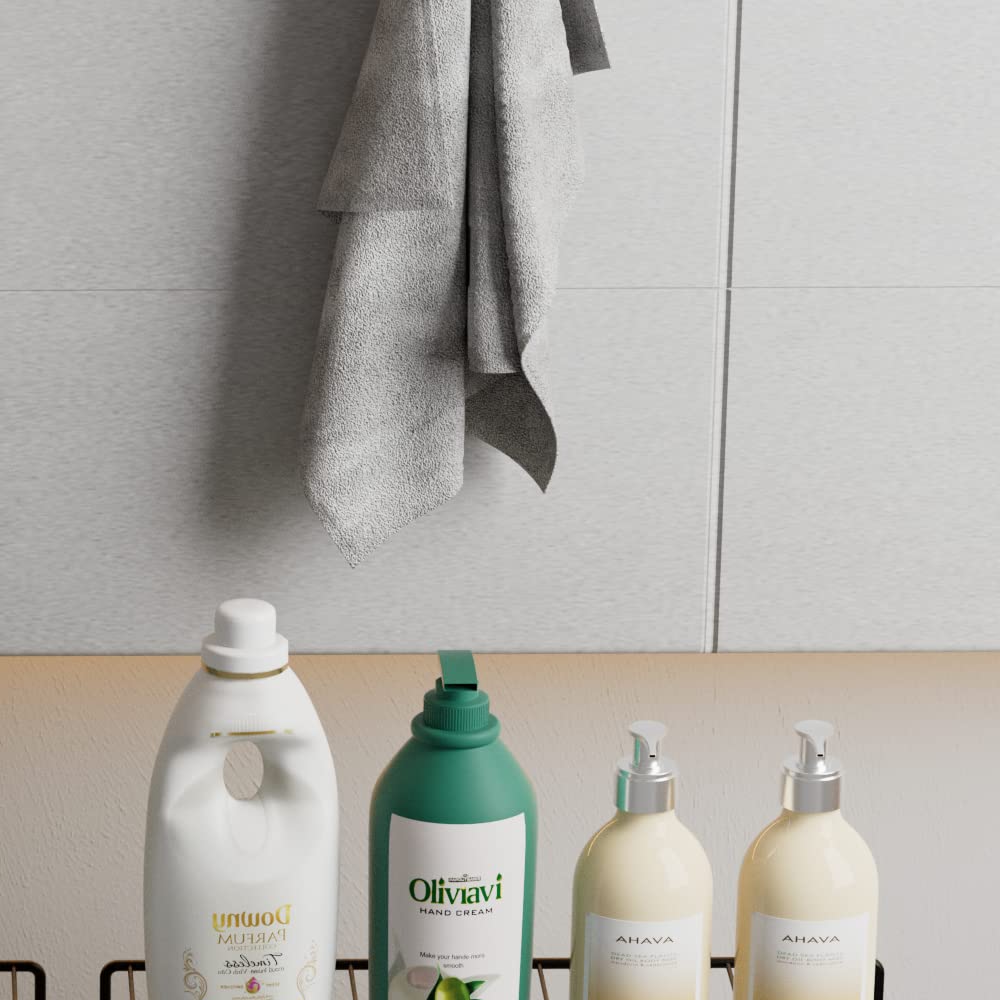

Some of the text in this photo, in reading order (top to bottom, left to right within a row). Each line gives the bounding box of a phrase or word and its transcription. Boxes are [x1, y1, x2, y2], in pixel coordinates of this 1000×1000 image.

[408, 872, 504, 905] Oliviavi
[419, 907, 494, 917] HAND CREAM
[616, 935, 674, 944] AHAVA
[782, 935, 840, 943] AHAVA
[419, 951, 436, 959] Make
[437, 953, 451, 961] your
